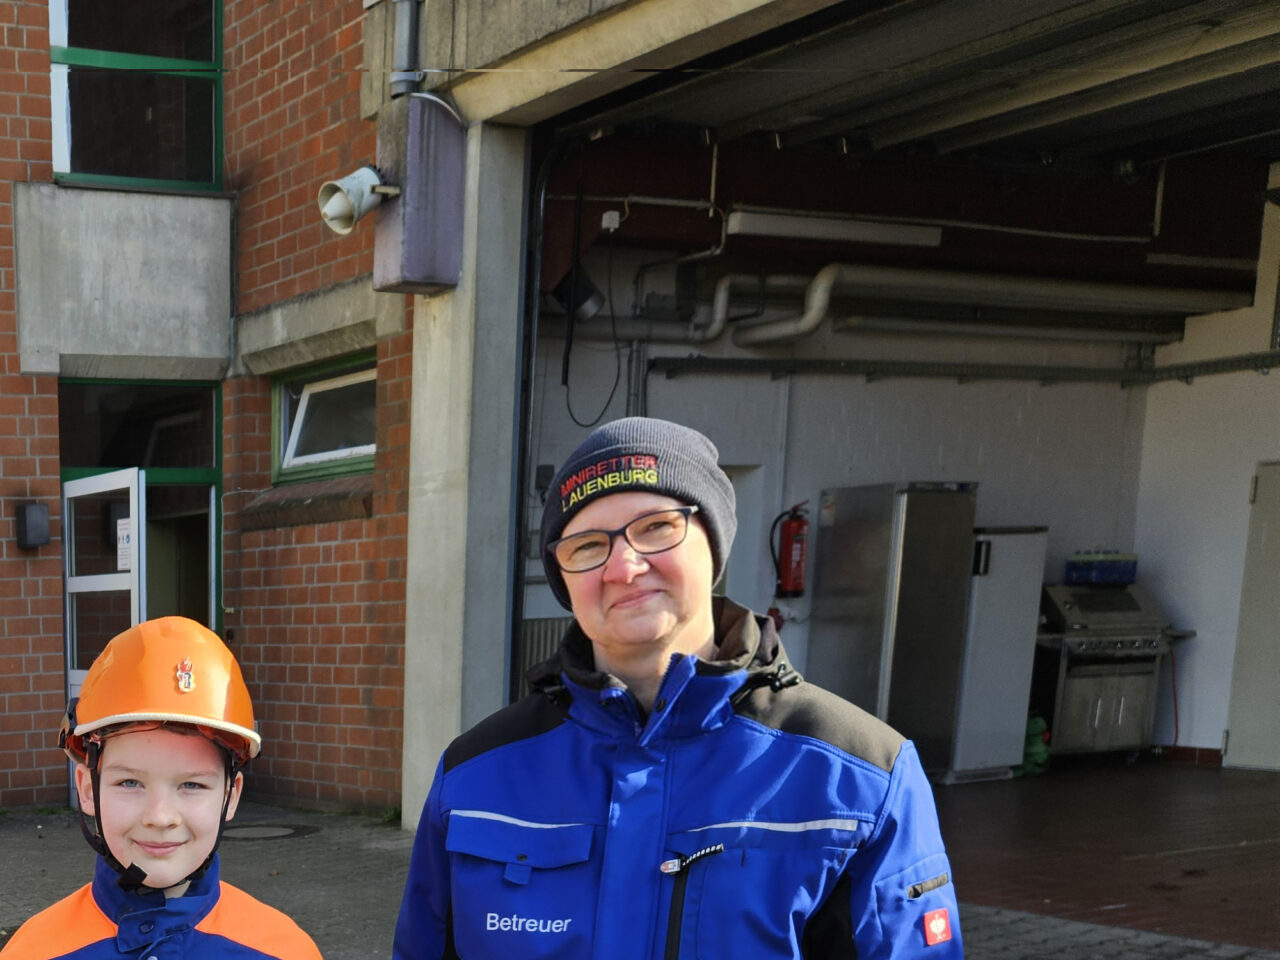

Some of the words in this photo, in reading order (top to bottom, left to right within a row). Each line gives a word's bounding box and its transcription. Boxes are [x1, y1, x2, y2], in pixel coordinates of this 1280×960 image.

[561, 455, 658, 497] MINIRETTER
[562, 469, 658, 512] LAUENBURG
[486, 913, 572, 932] Betreuer
